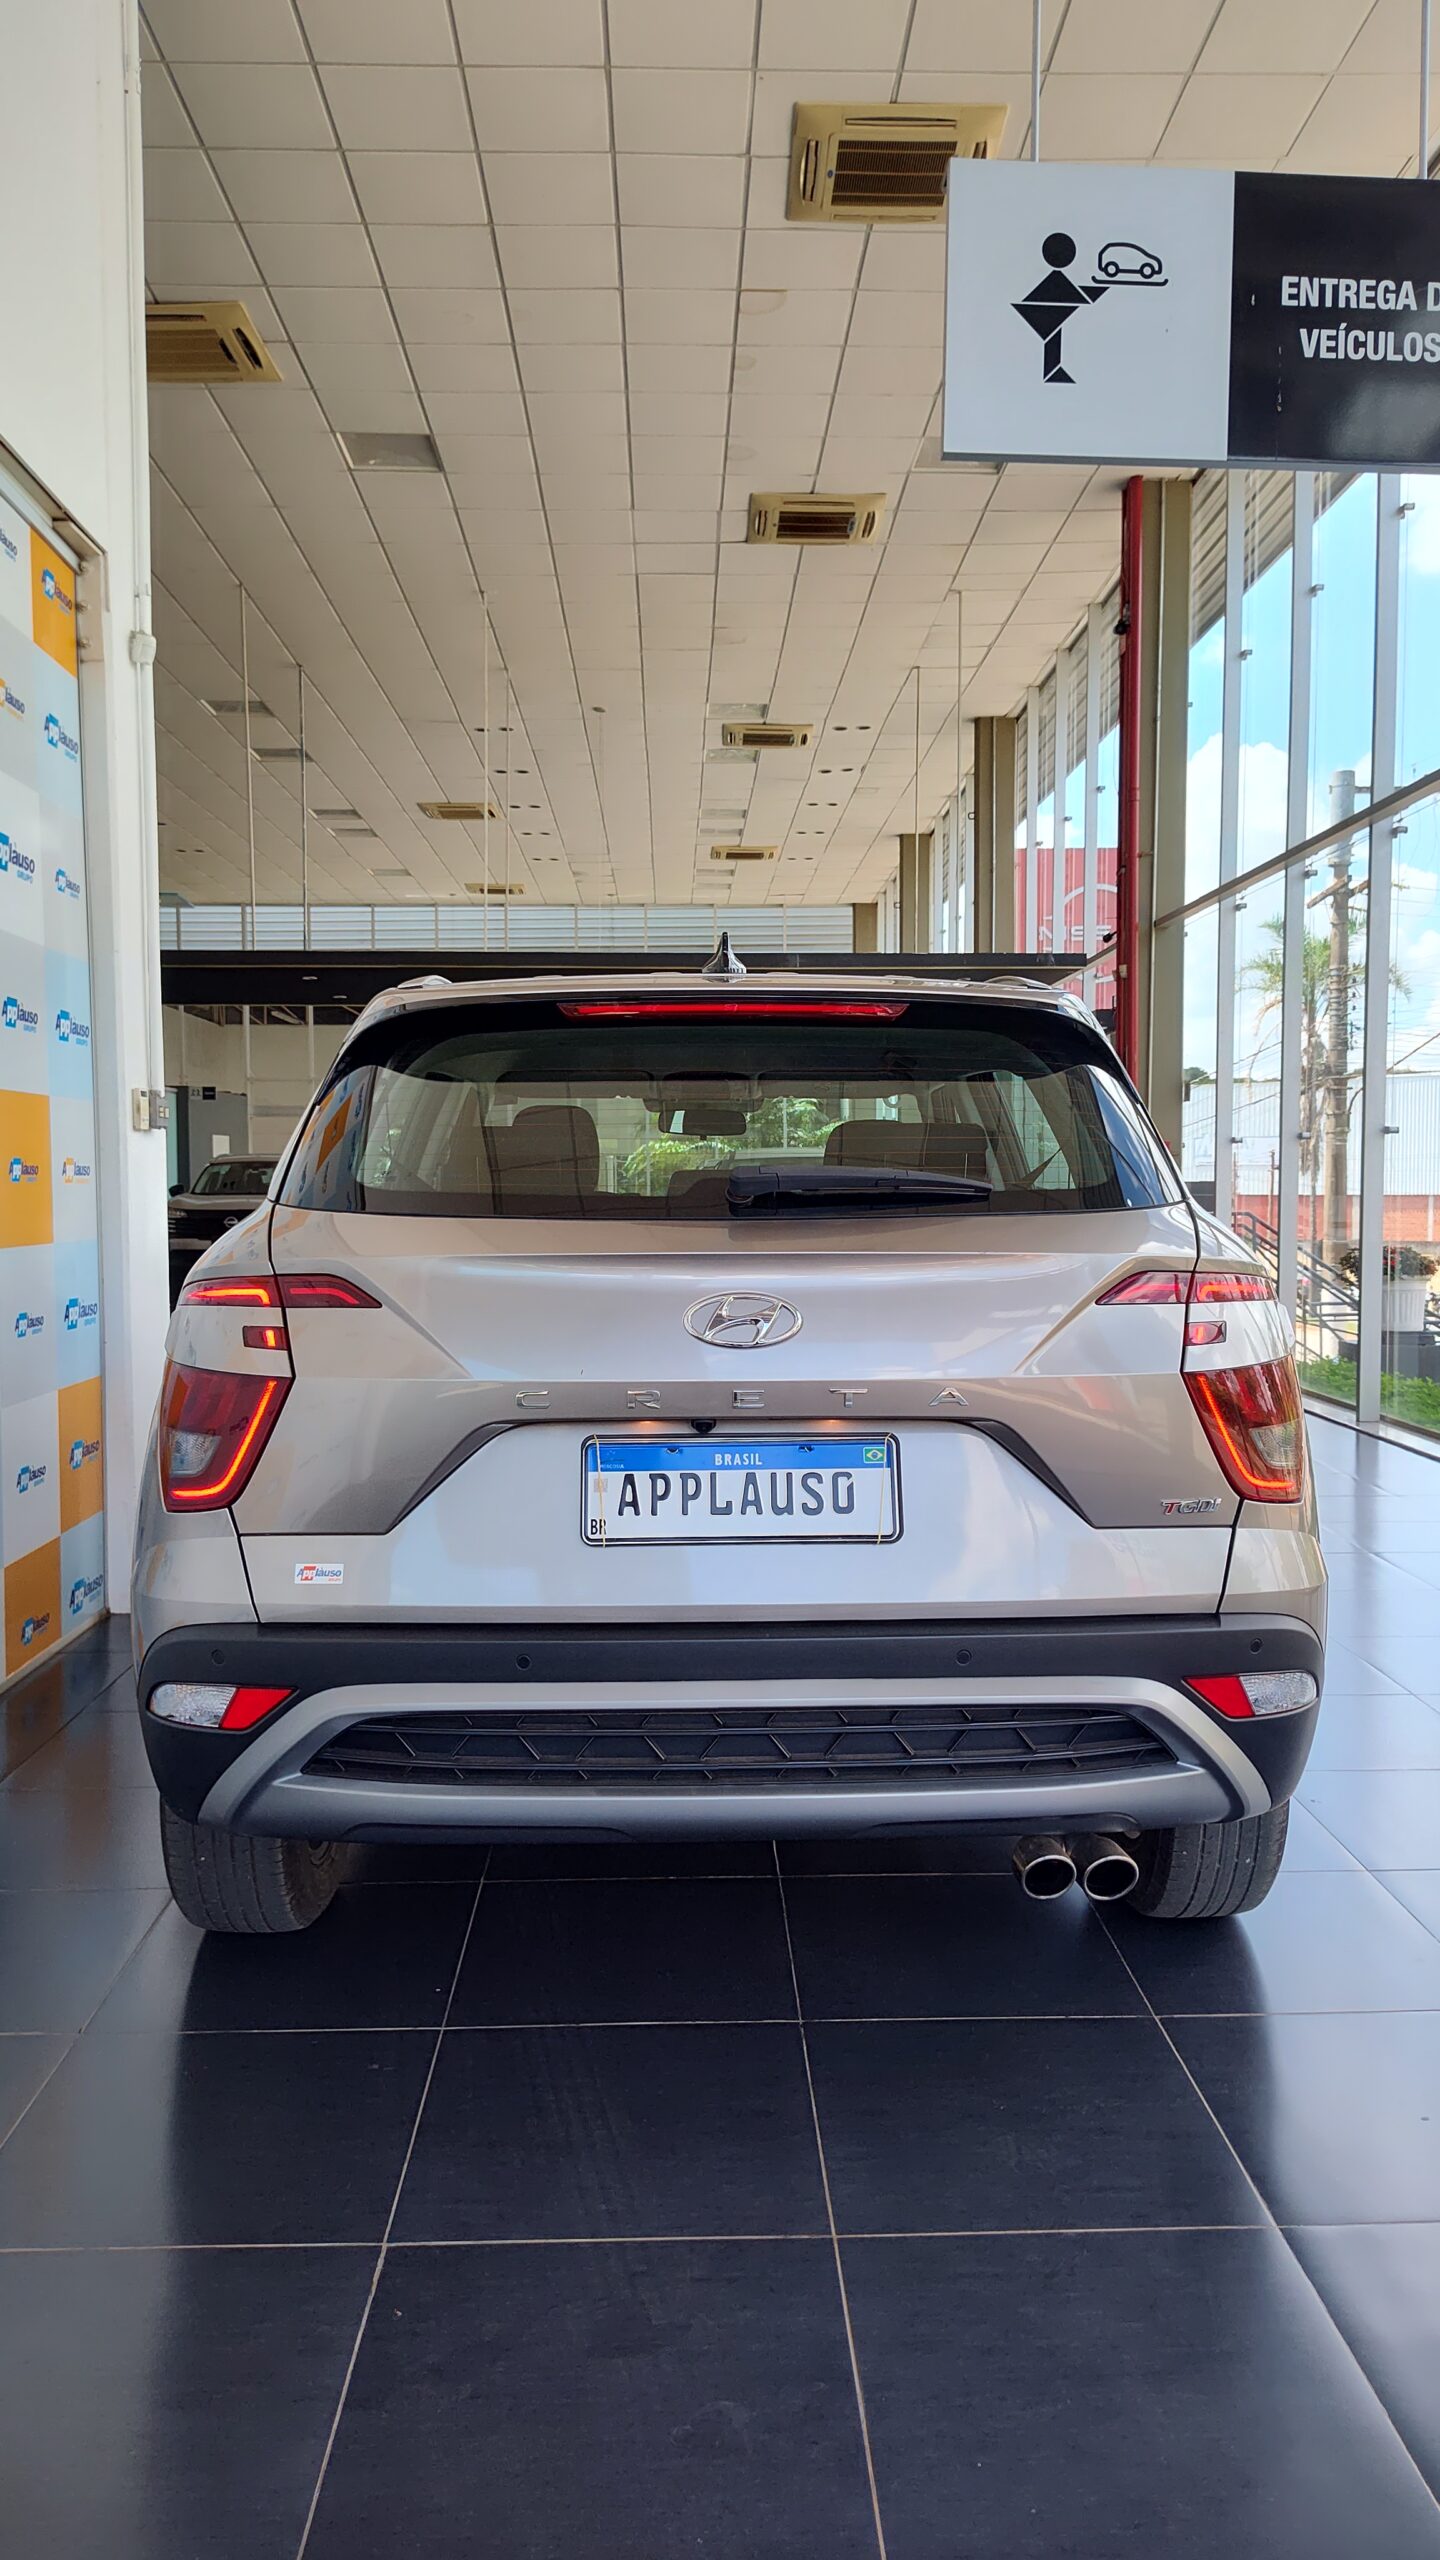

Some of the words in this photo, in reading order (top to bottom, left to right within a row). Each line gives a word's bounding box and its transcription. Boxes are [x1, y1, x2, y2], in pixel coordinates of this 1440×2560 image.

[1281, 275, 1418, 311] ENTREGA
[1427, 281, 1440, 312] D
[1299, 322, 1440, 363] VEÍCULOS
[515, 1387, 970, 1410] CRETA
[714, 1453, 763, 1466] BRASIL
[618, 1471, 855, 1516] APPLAUSO
[590, 1518, 607, 1535] BR
